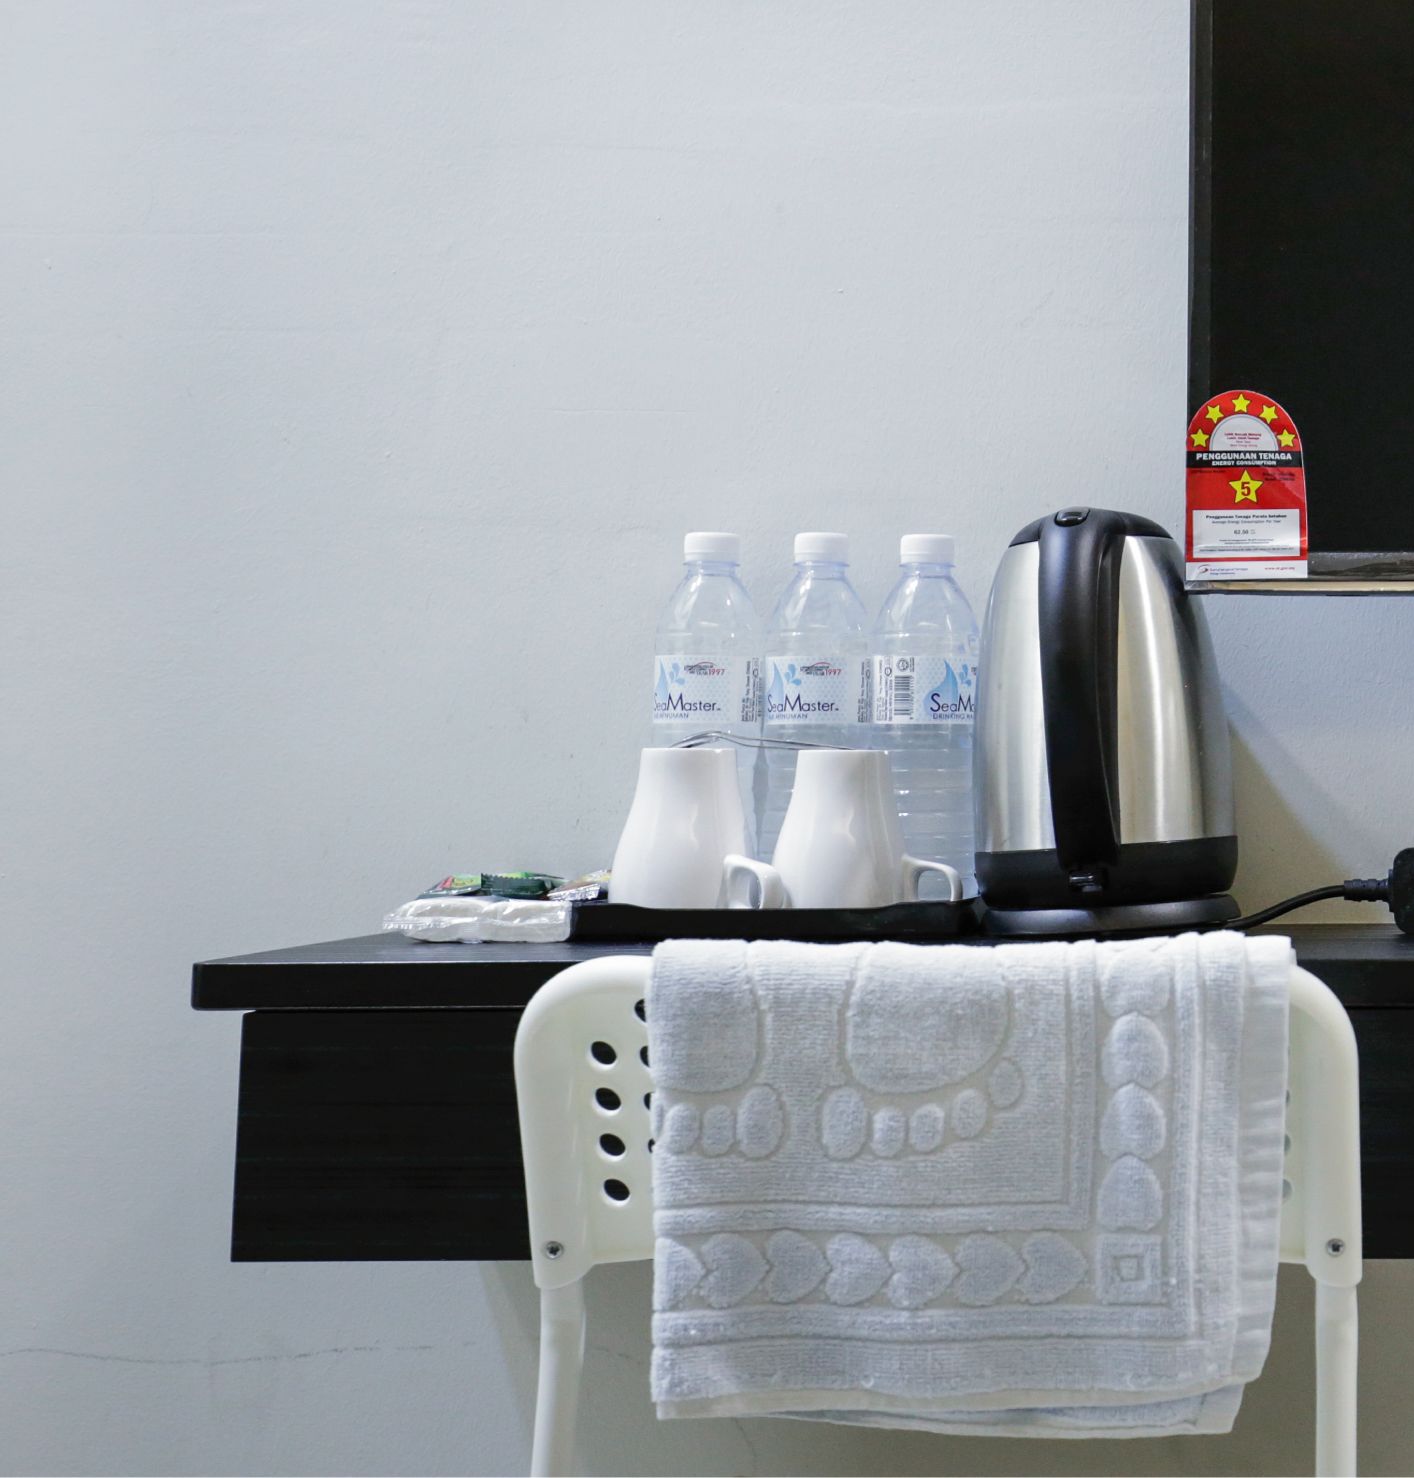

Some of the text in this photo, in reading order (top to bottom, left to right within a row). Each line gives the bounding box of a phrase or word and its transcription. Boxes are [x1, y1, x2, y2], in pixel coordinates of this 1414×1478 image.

[1196, 452, 1292, 460] PENGGUNAAN TENAGA
[1241, 481, 1251, 496] 5
[767, 693, 835, 713] SeaMaster
